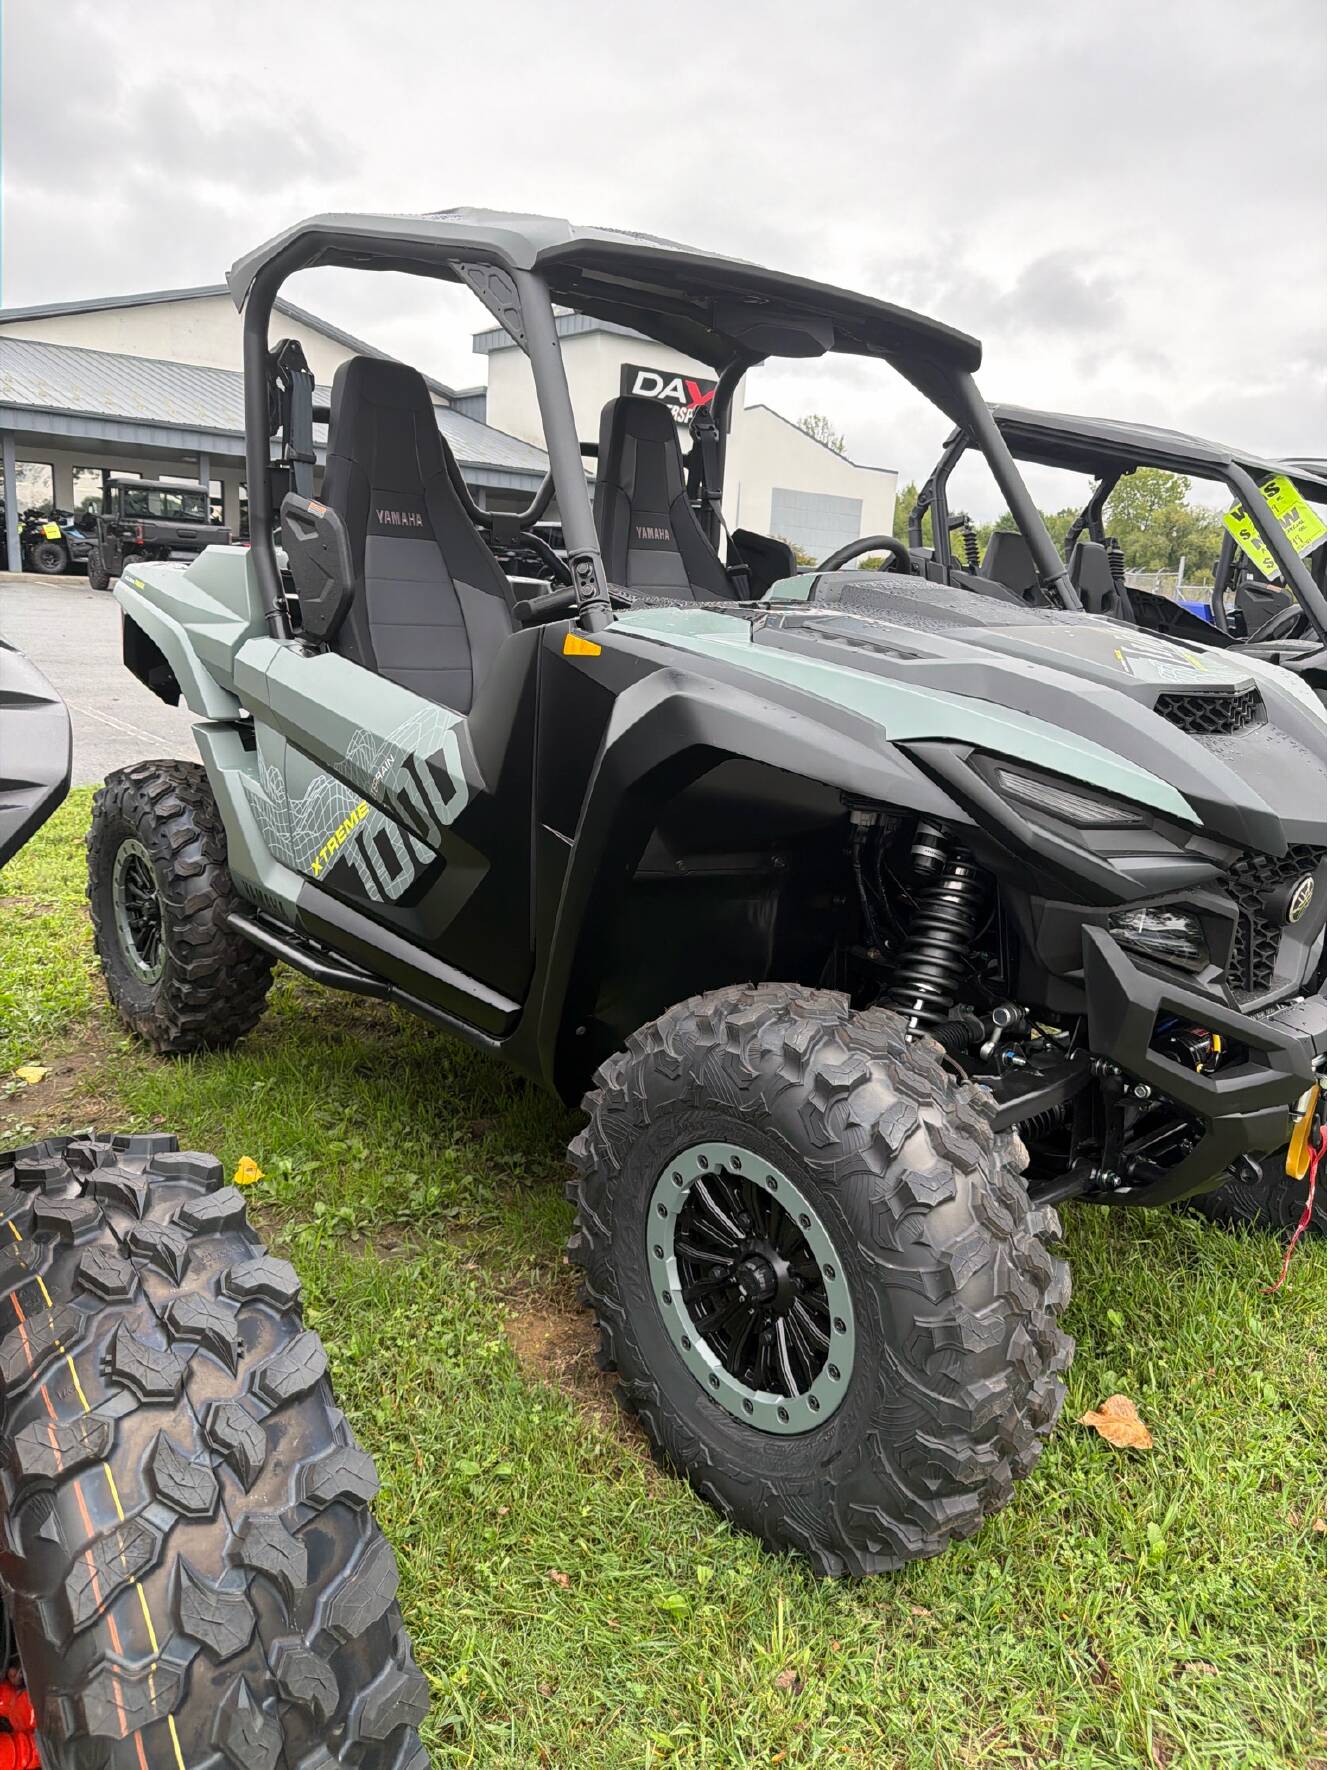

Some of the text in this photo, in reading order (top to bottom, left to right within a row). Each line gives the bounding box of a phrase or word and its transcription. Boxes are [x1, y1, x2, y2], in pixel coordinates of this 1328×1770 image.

[376, 509, 423, 527] YAMAHA
[636, 526, 670, 541] YAMAHA
[311, 800, 371, 877] XTREME
[342, 729, 469, 903] 1000
